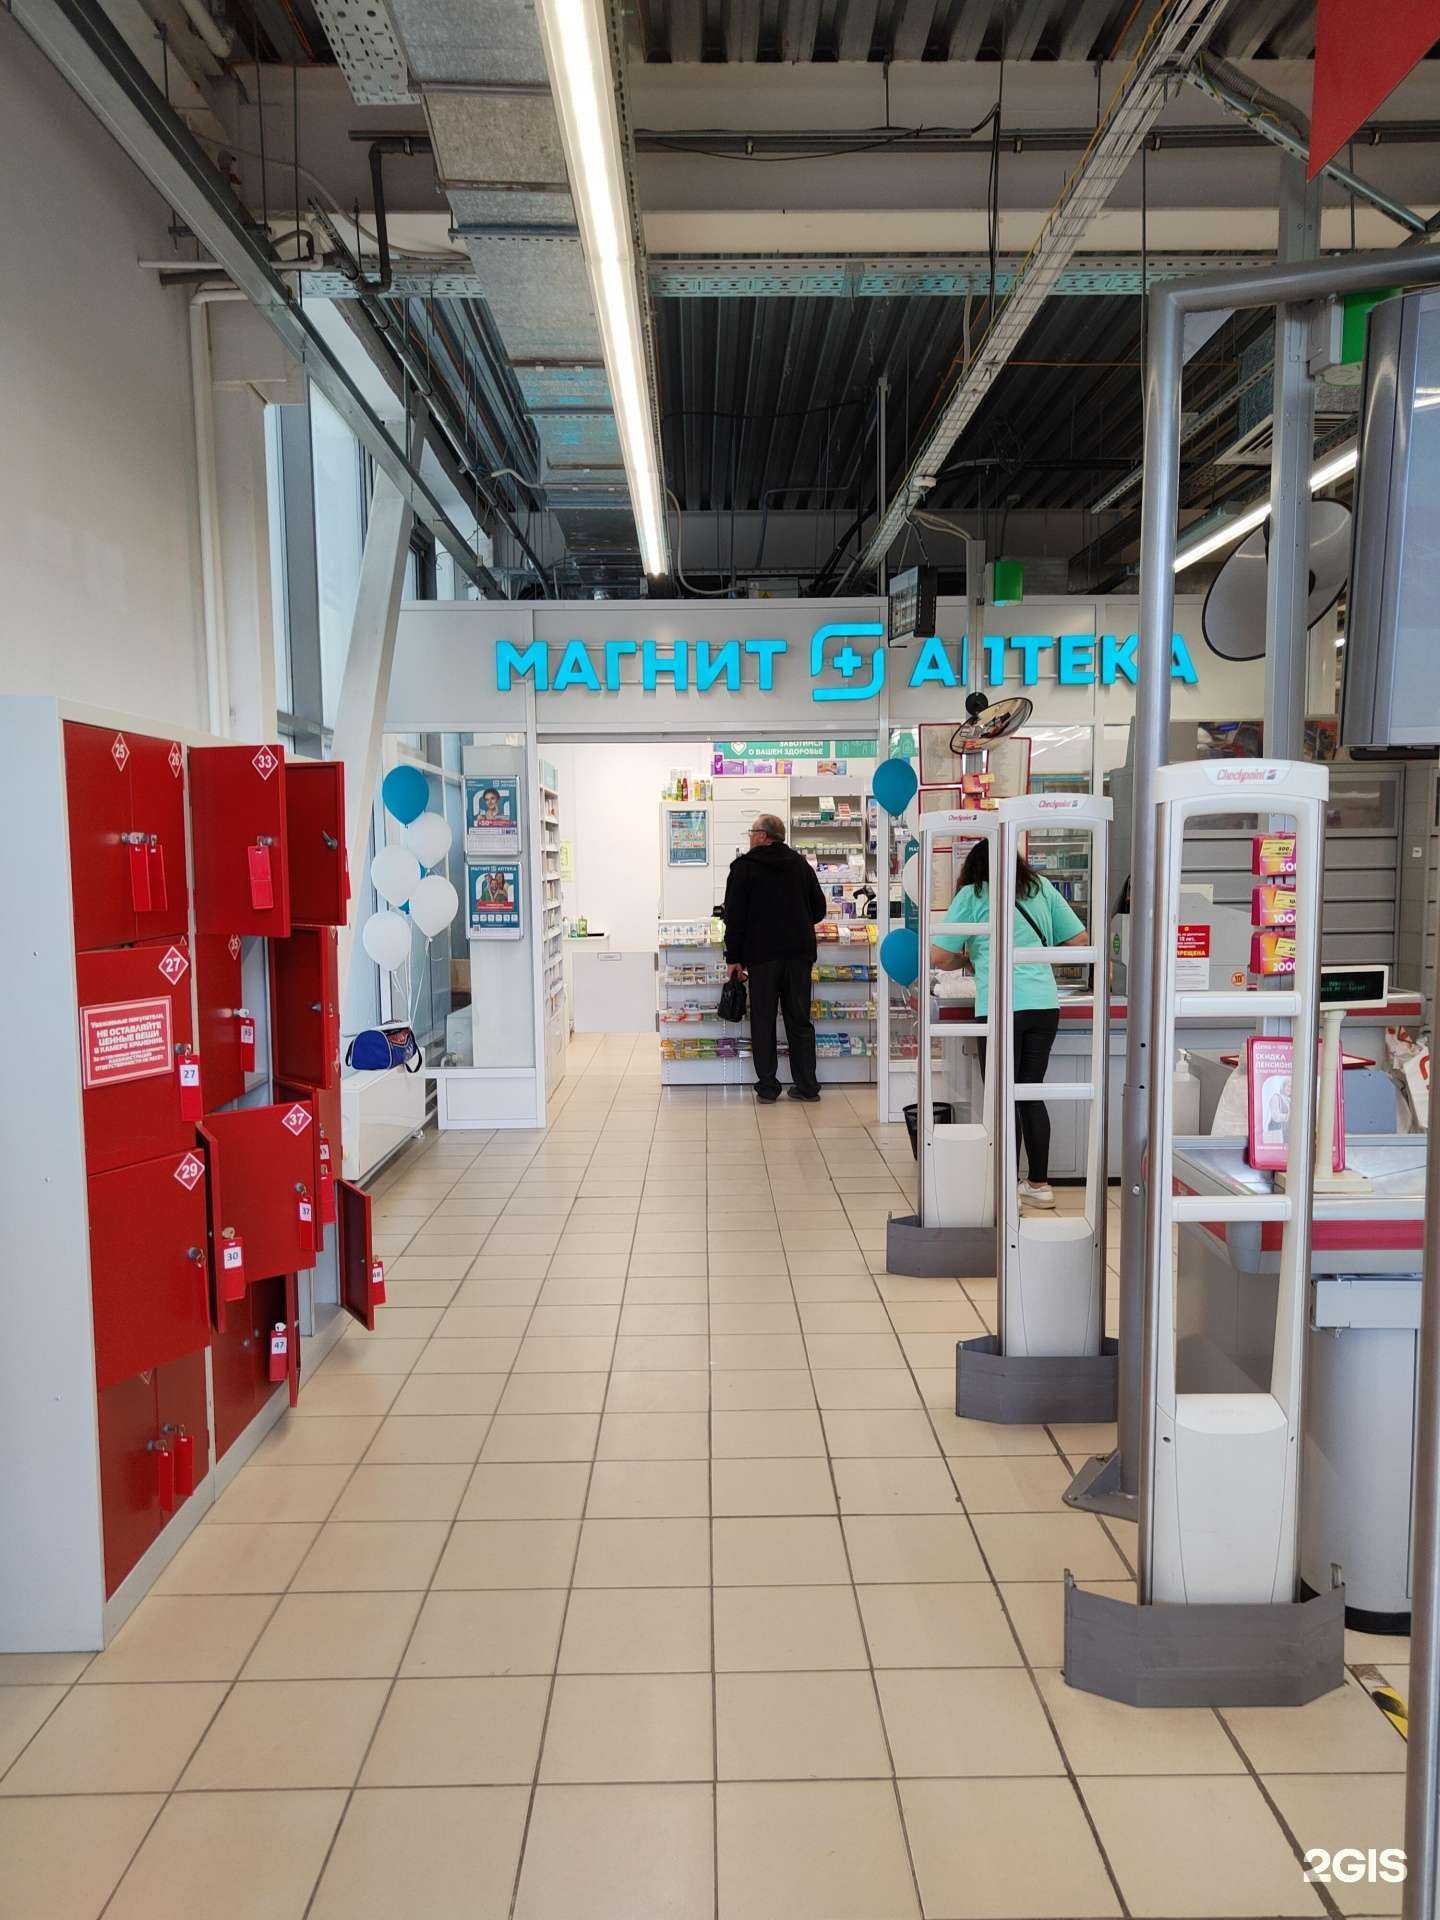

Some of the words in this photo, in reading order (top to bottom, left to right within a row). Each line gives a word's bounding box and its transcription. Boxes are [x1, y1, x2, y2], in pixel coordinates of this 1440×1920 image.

[496, 640, 787, 692] МАГНИТ
[114, 743, 124, 758] 25
[785, 748, 824, 756] ЗДОРОВЬЕ
[172, 752, 180, 767] 26
[258, 755, 272, 769] 33
[1216, 768, 1264, 783] Checkpoint
[166, 957, 180, 972] 27
[97, 1030, 108, 1038] НЕ
[110, 1022, 162, 1036] ОСТАВЛЯЙТЕ
[99, 1034, 134, 1046] ЦЕННЫЕ
[135, 1031, 160, 1040] ВЕЩИ
[100, 1043, 128, 1054] КАМЕРЕ
[1256, 1054, 1286, 1062] СКИДКА
[184, 1070, 196, 1079] 27
[289, 1112, 304, 1126] 37
[182, 1164, 198, 1179] 29
[226, 1251, 240, 1262] 30
[274, 1341, 285, 1350] 47
